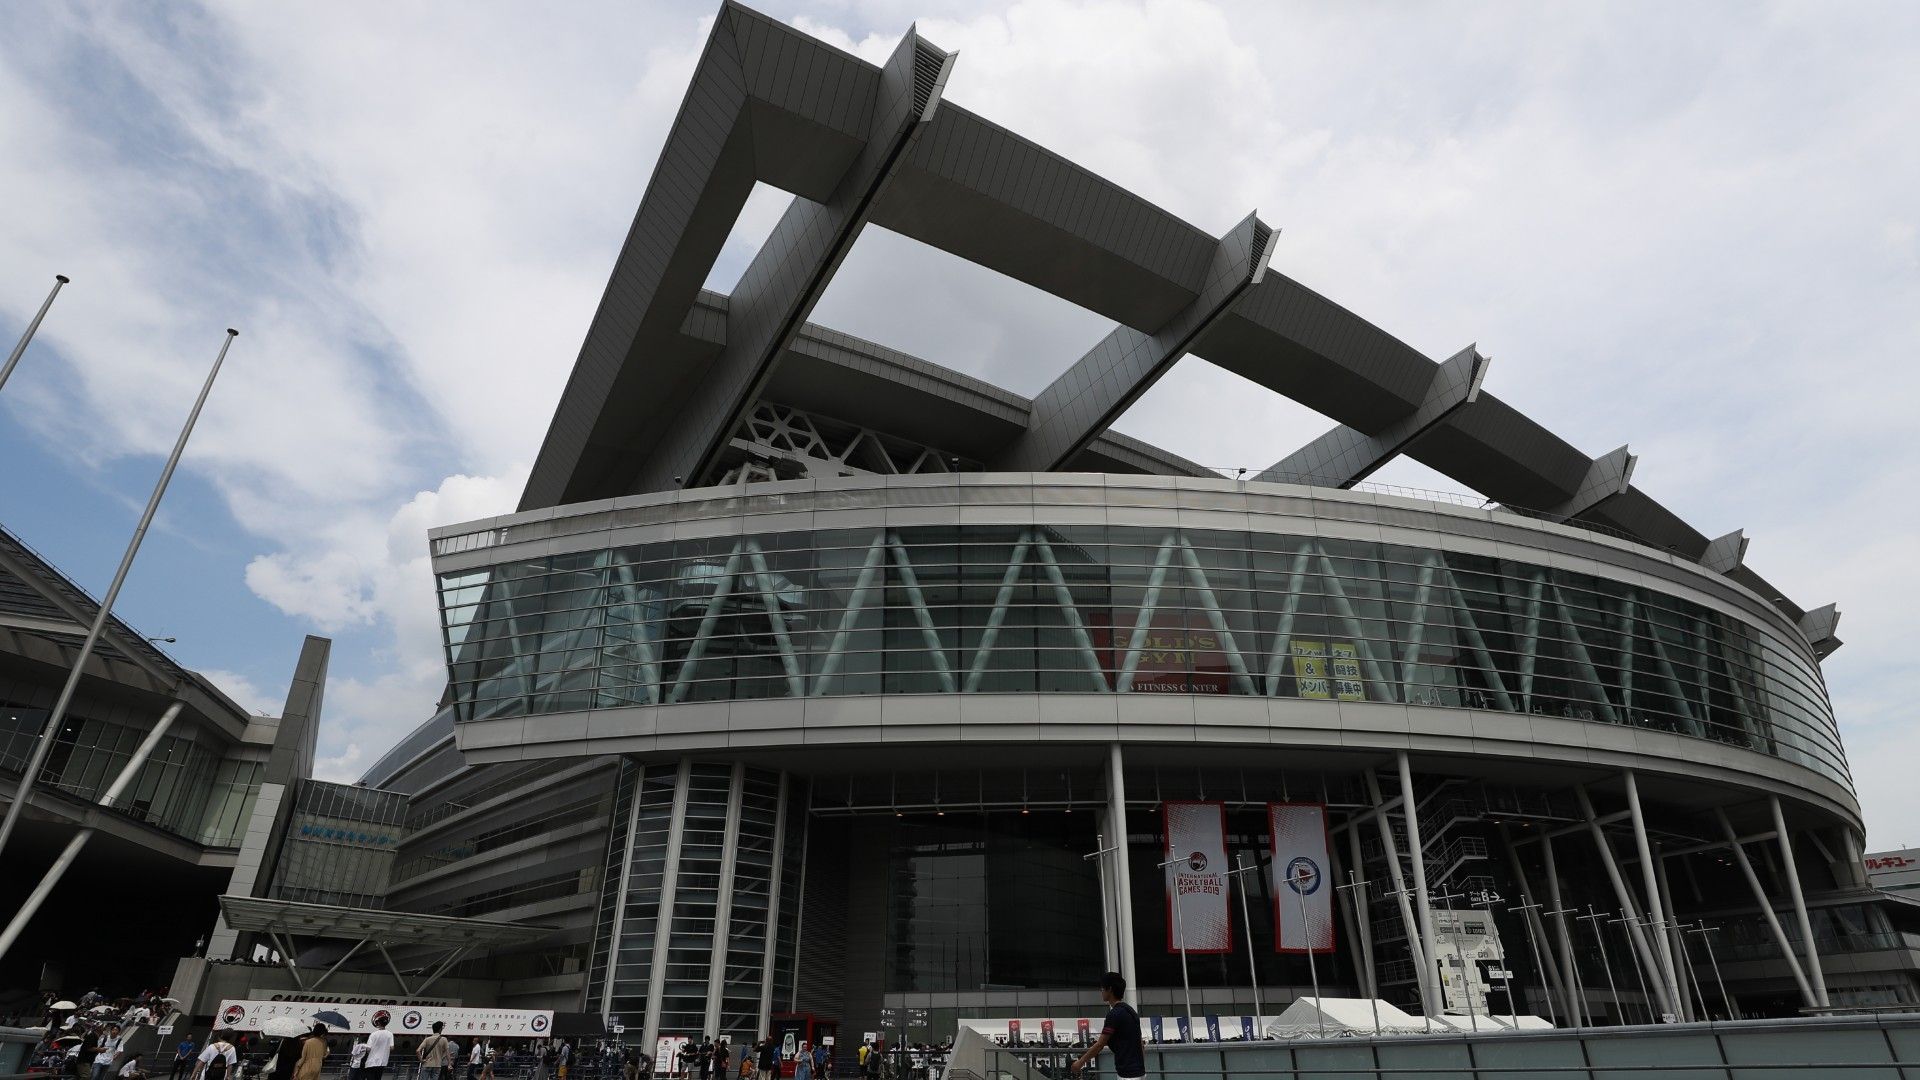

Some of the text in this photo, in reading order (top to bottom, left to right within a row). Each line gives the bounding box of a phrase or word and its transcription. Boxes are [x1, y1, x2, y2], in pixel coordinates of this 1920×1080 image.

[1294, 647, 1352, 659] フィッネス
[1137, 683, 1178, 692] FITNESS
[1180, 684, 1218, 692] CNTER
[1179, 886, 1220, 895] GAMES 2019
